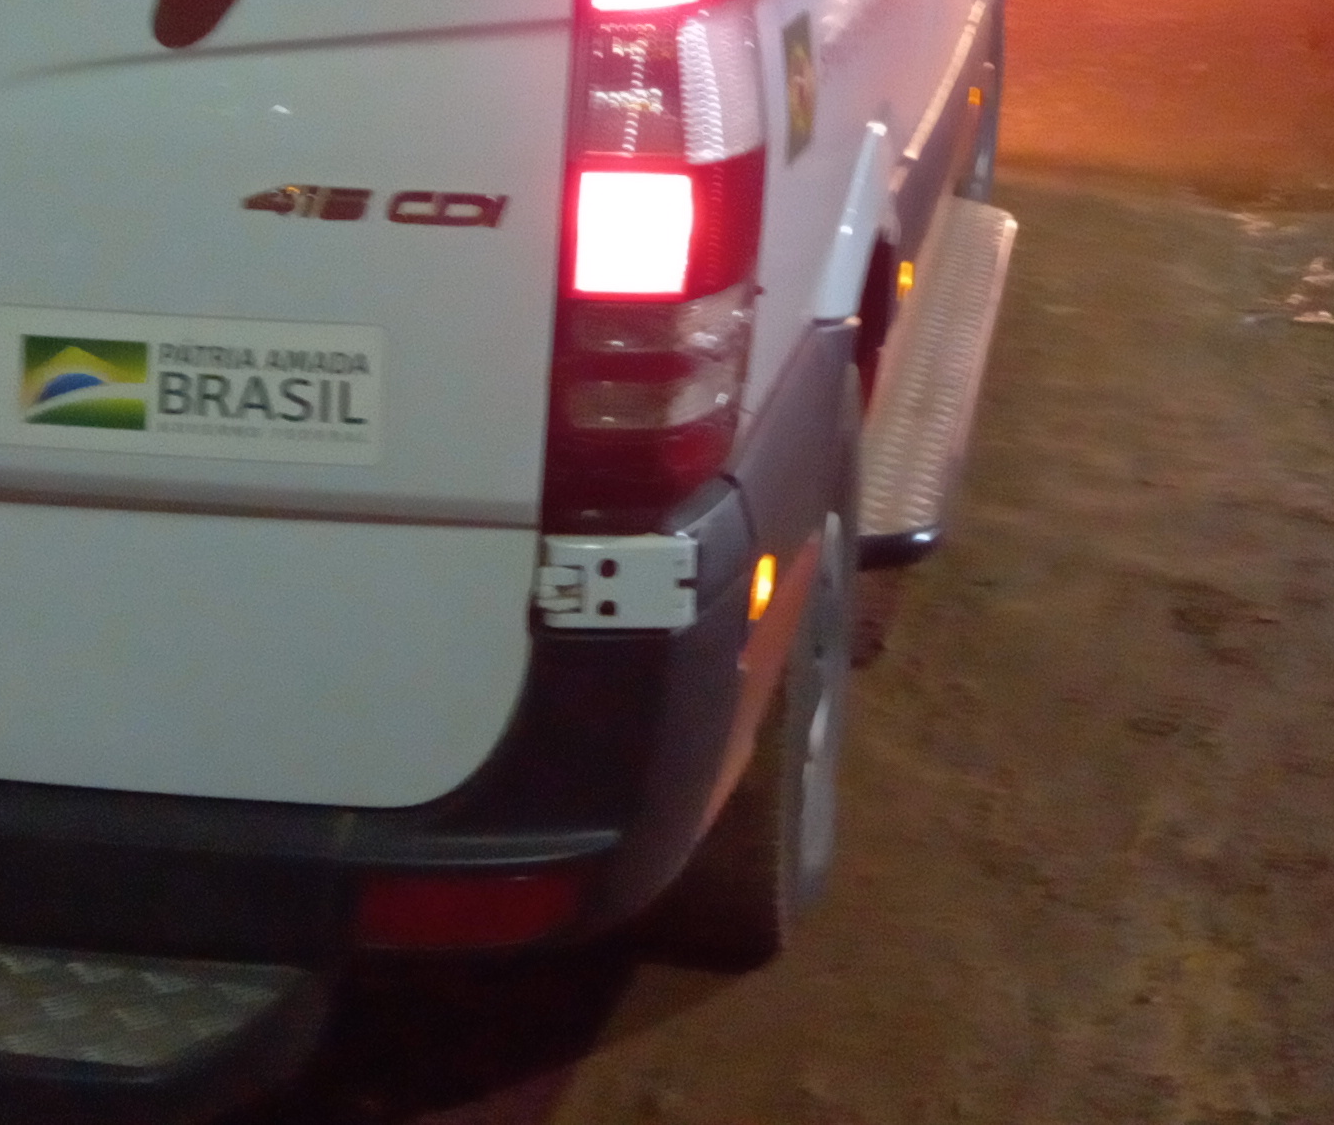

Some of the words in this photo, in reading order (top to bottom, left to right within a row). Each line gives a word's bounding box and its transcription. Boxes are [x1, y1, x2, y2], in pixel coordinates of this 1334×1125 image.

[387, 189, 509, 229] CDI
[267, 347, 369, 375] AMADA
[157, 371, 369, 425] BRASIL
